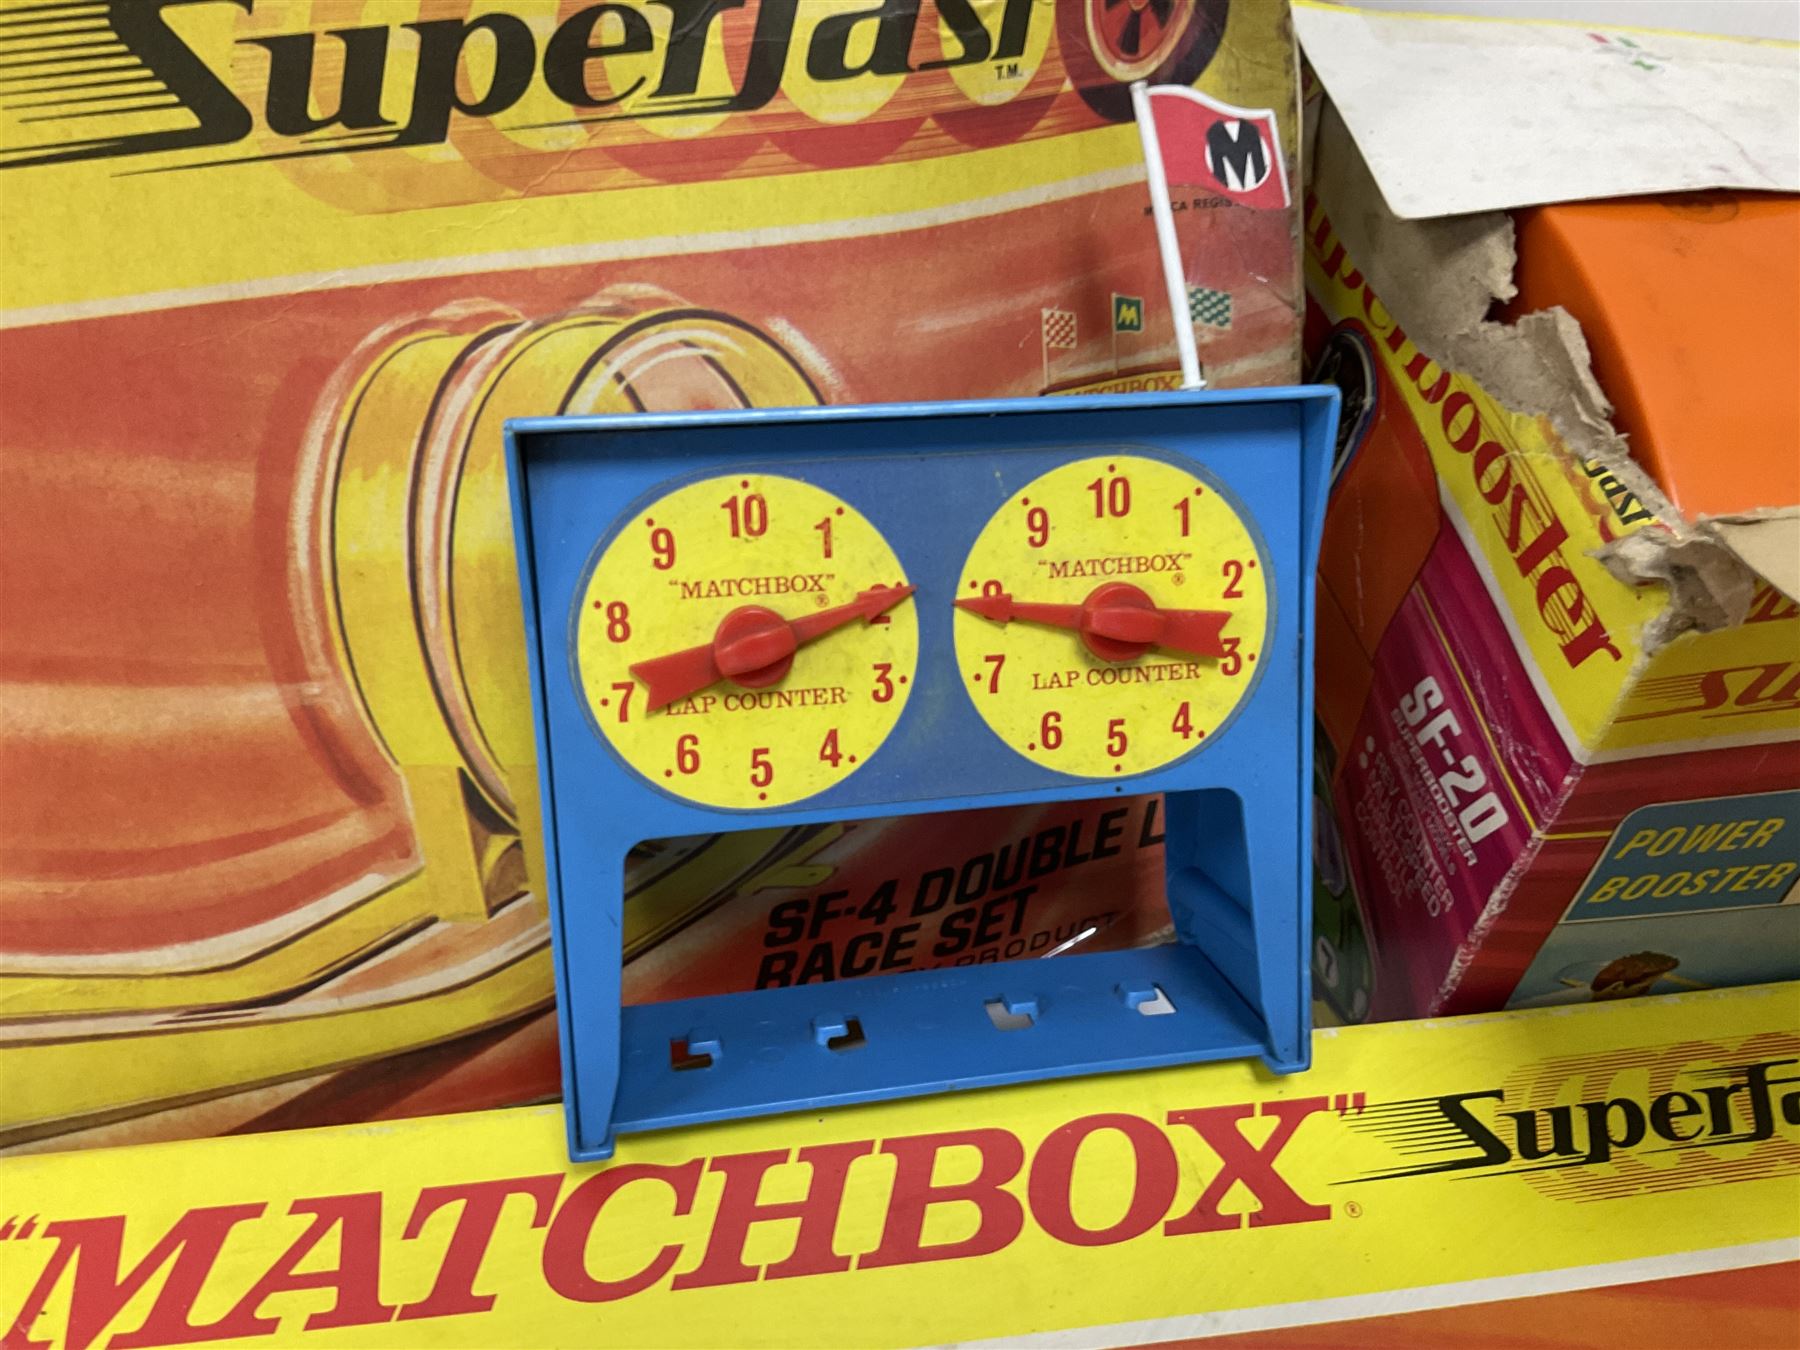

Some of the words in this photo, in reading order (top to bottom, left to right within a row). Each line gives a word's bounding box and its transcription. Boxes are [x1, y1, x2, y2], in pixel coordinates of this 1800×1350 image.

[1206, 119, 1267, 191] M
[1144, 201, 1187, 216] MCA
[721, 494, 768, 538] 10
[1087, 477, 1131, 518] 10
[1173, 497, 1190, 537] 1
[814, 517, 833, 559] 1
[1027, 507, 1050, 548] 9
[651, 528, 676, 570] 9
[1038, 553, 1192, 579] "MATCHBOX"
[669, 573, 835, 600] "MATCHBOX"
[1222, 560, 1244, 599] 2
[606, 601, 632, 643] 8
[984, 655, 1006, 694] 7
[1033, 671, 1080, 690] LAP
[1087, 662, 1201, 686] COUNTER
[1221, 637, 1242, 677] 3
[612, 681, 635, 722] 7
[665, 696, 717, 717] LAP
[724, 686, 848, 711] COUNTER
[872, 663, 895, 703] 3
[1041, 711, 1063, 750] 6
[1107, 718, 1128, 757] 5
[1171, 702, 1194, 739] 4
[676, 734, 701, 775] 6
[750, 748, 774, 788] 5
[819, 729, 843, 768] 4
[1400, 675, 1509, 844] SF-20
[1614, 818, 1785, 860] POWER
[911, 808, 1129, 917] DOUBLE
[1586, 862, 1797, 904] BOOSTER
[755, 922, 921, 991] RACE
[933, 886, 1037, 957] SET
[0, 1092, 1366, 1350] "MATCHBOX"
